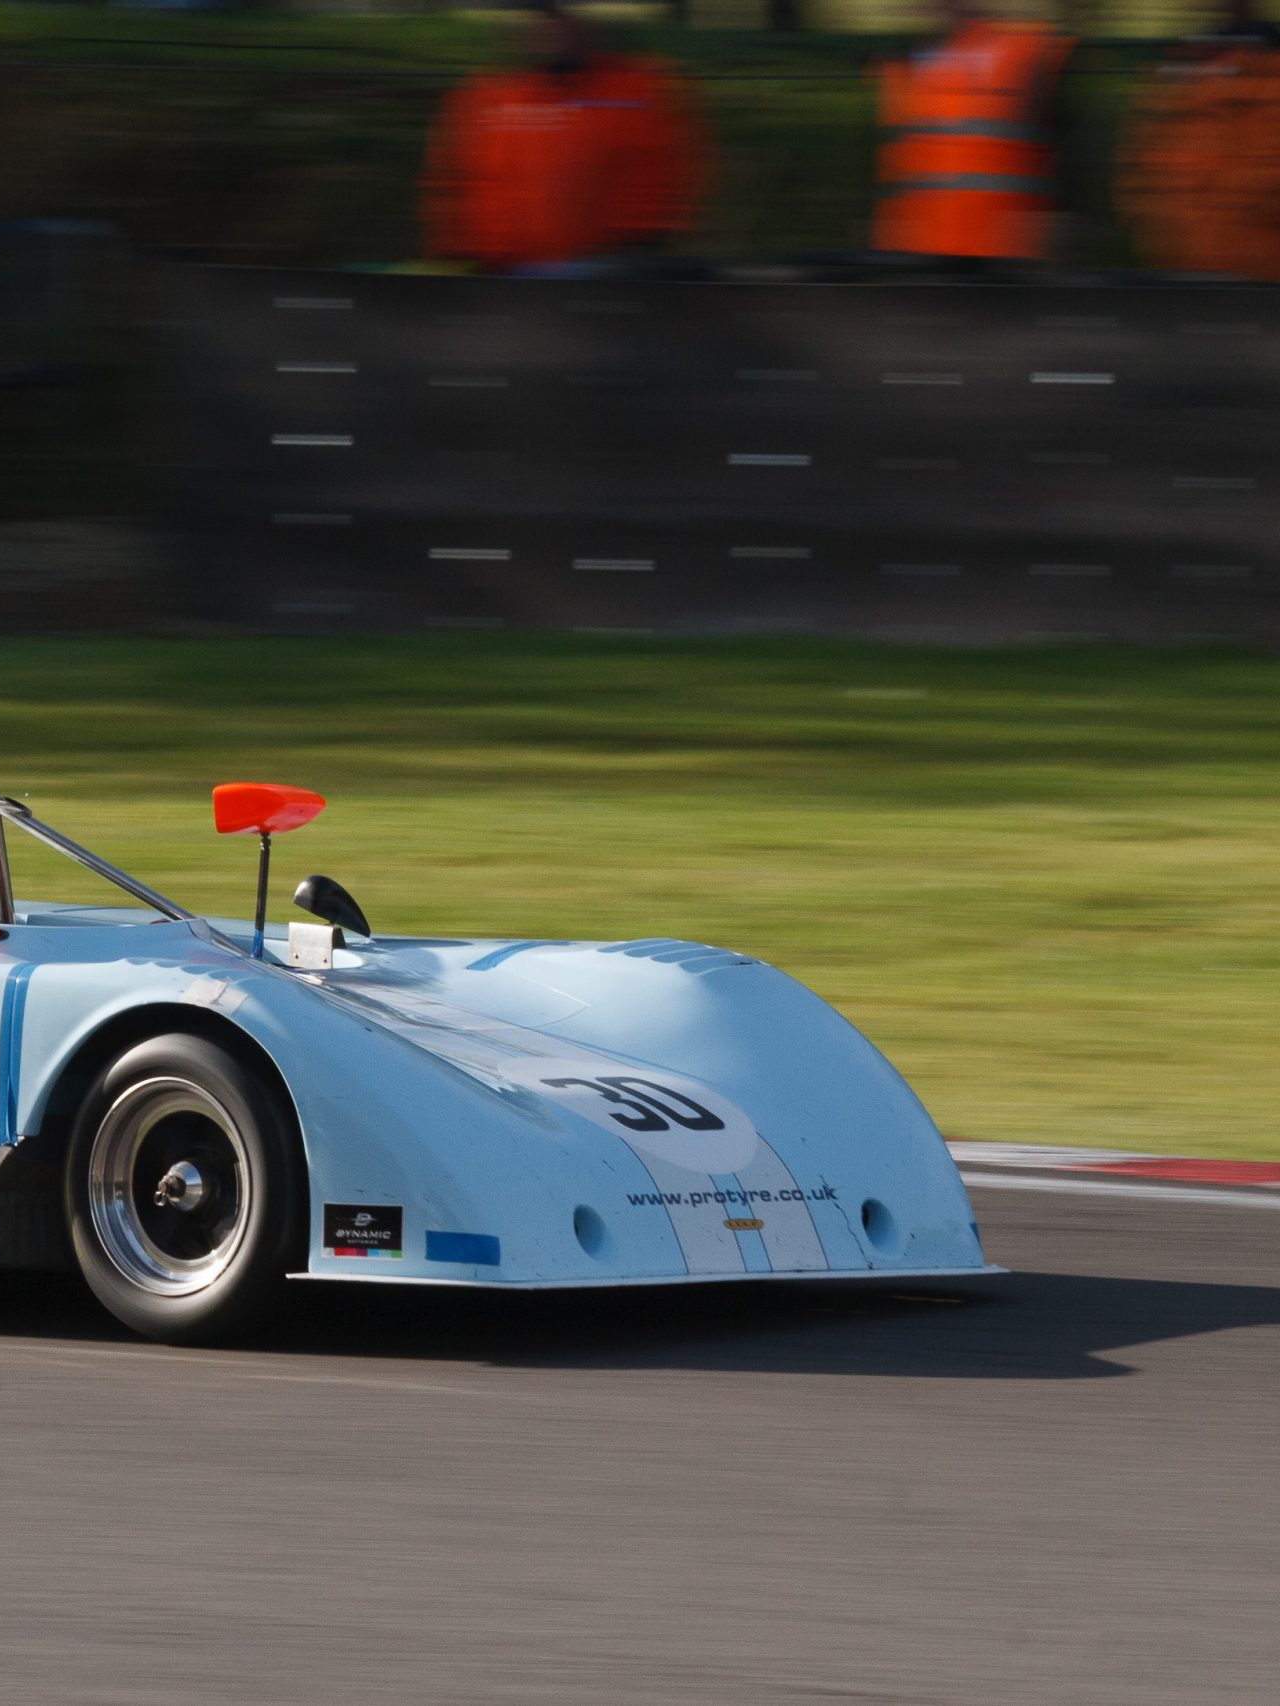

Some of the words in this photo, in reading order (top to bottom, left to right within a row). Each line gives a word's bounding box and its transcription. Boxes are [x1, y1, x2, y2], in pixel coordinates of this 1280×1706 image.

[539, 1076, 725, 1131] 30
[626, 1185, 839, 1208] www.protyre.co.uk
[336, 1229, 392, 1240] DYNAMIC
